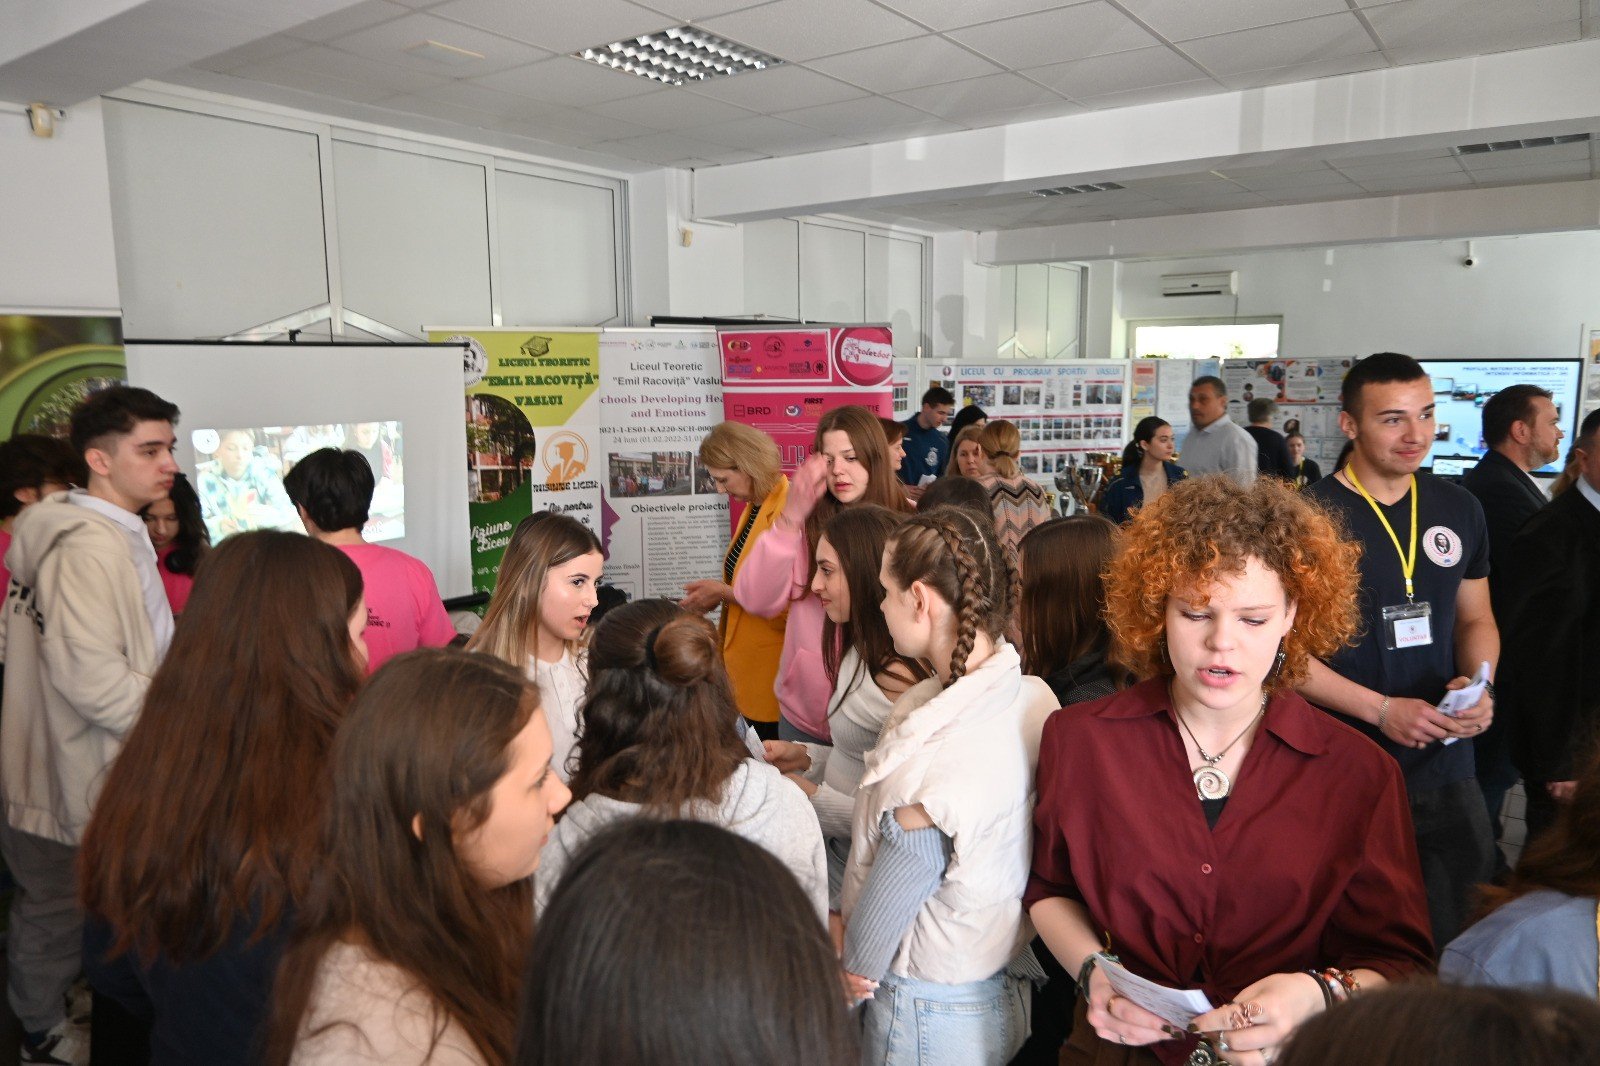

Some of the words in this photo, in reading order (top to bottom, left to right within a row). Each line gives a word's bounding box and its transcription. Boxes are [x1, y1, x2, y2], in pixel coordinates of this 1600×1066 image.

[498, 357, 536, 367] LICEUL
[538, 357, 591, 367] TEORETIC
[630, 362, 660, 371] Liceul
[662, 362, 703, 371] Teoretic
[960, 367, 986, 376] LICEUL
[993, 367, 1004, 376] CU
[1013, 367, 1052, 376] PROGRAM
[1057, 367, 1087, 376] SPORTIV
[1096, 367, 1120, 376] VASLUI
[515, 395, 563, 406] VASLUI
[599, 394, 637, 404] chools
[641, 394, 702, 405] Developing
[630, 408, 651, 418] and
[655, 408, 707, 418] Emotions
[747, 406, 771, 415] BRD
[631, 503, 686, 513] Obiectivele
